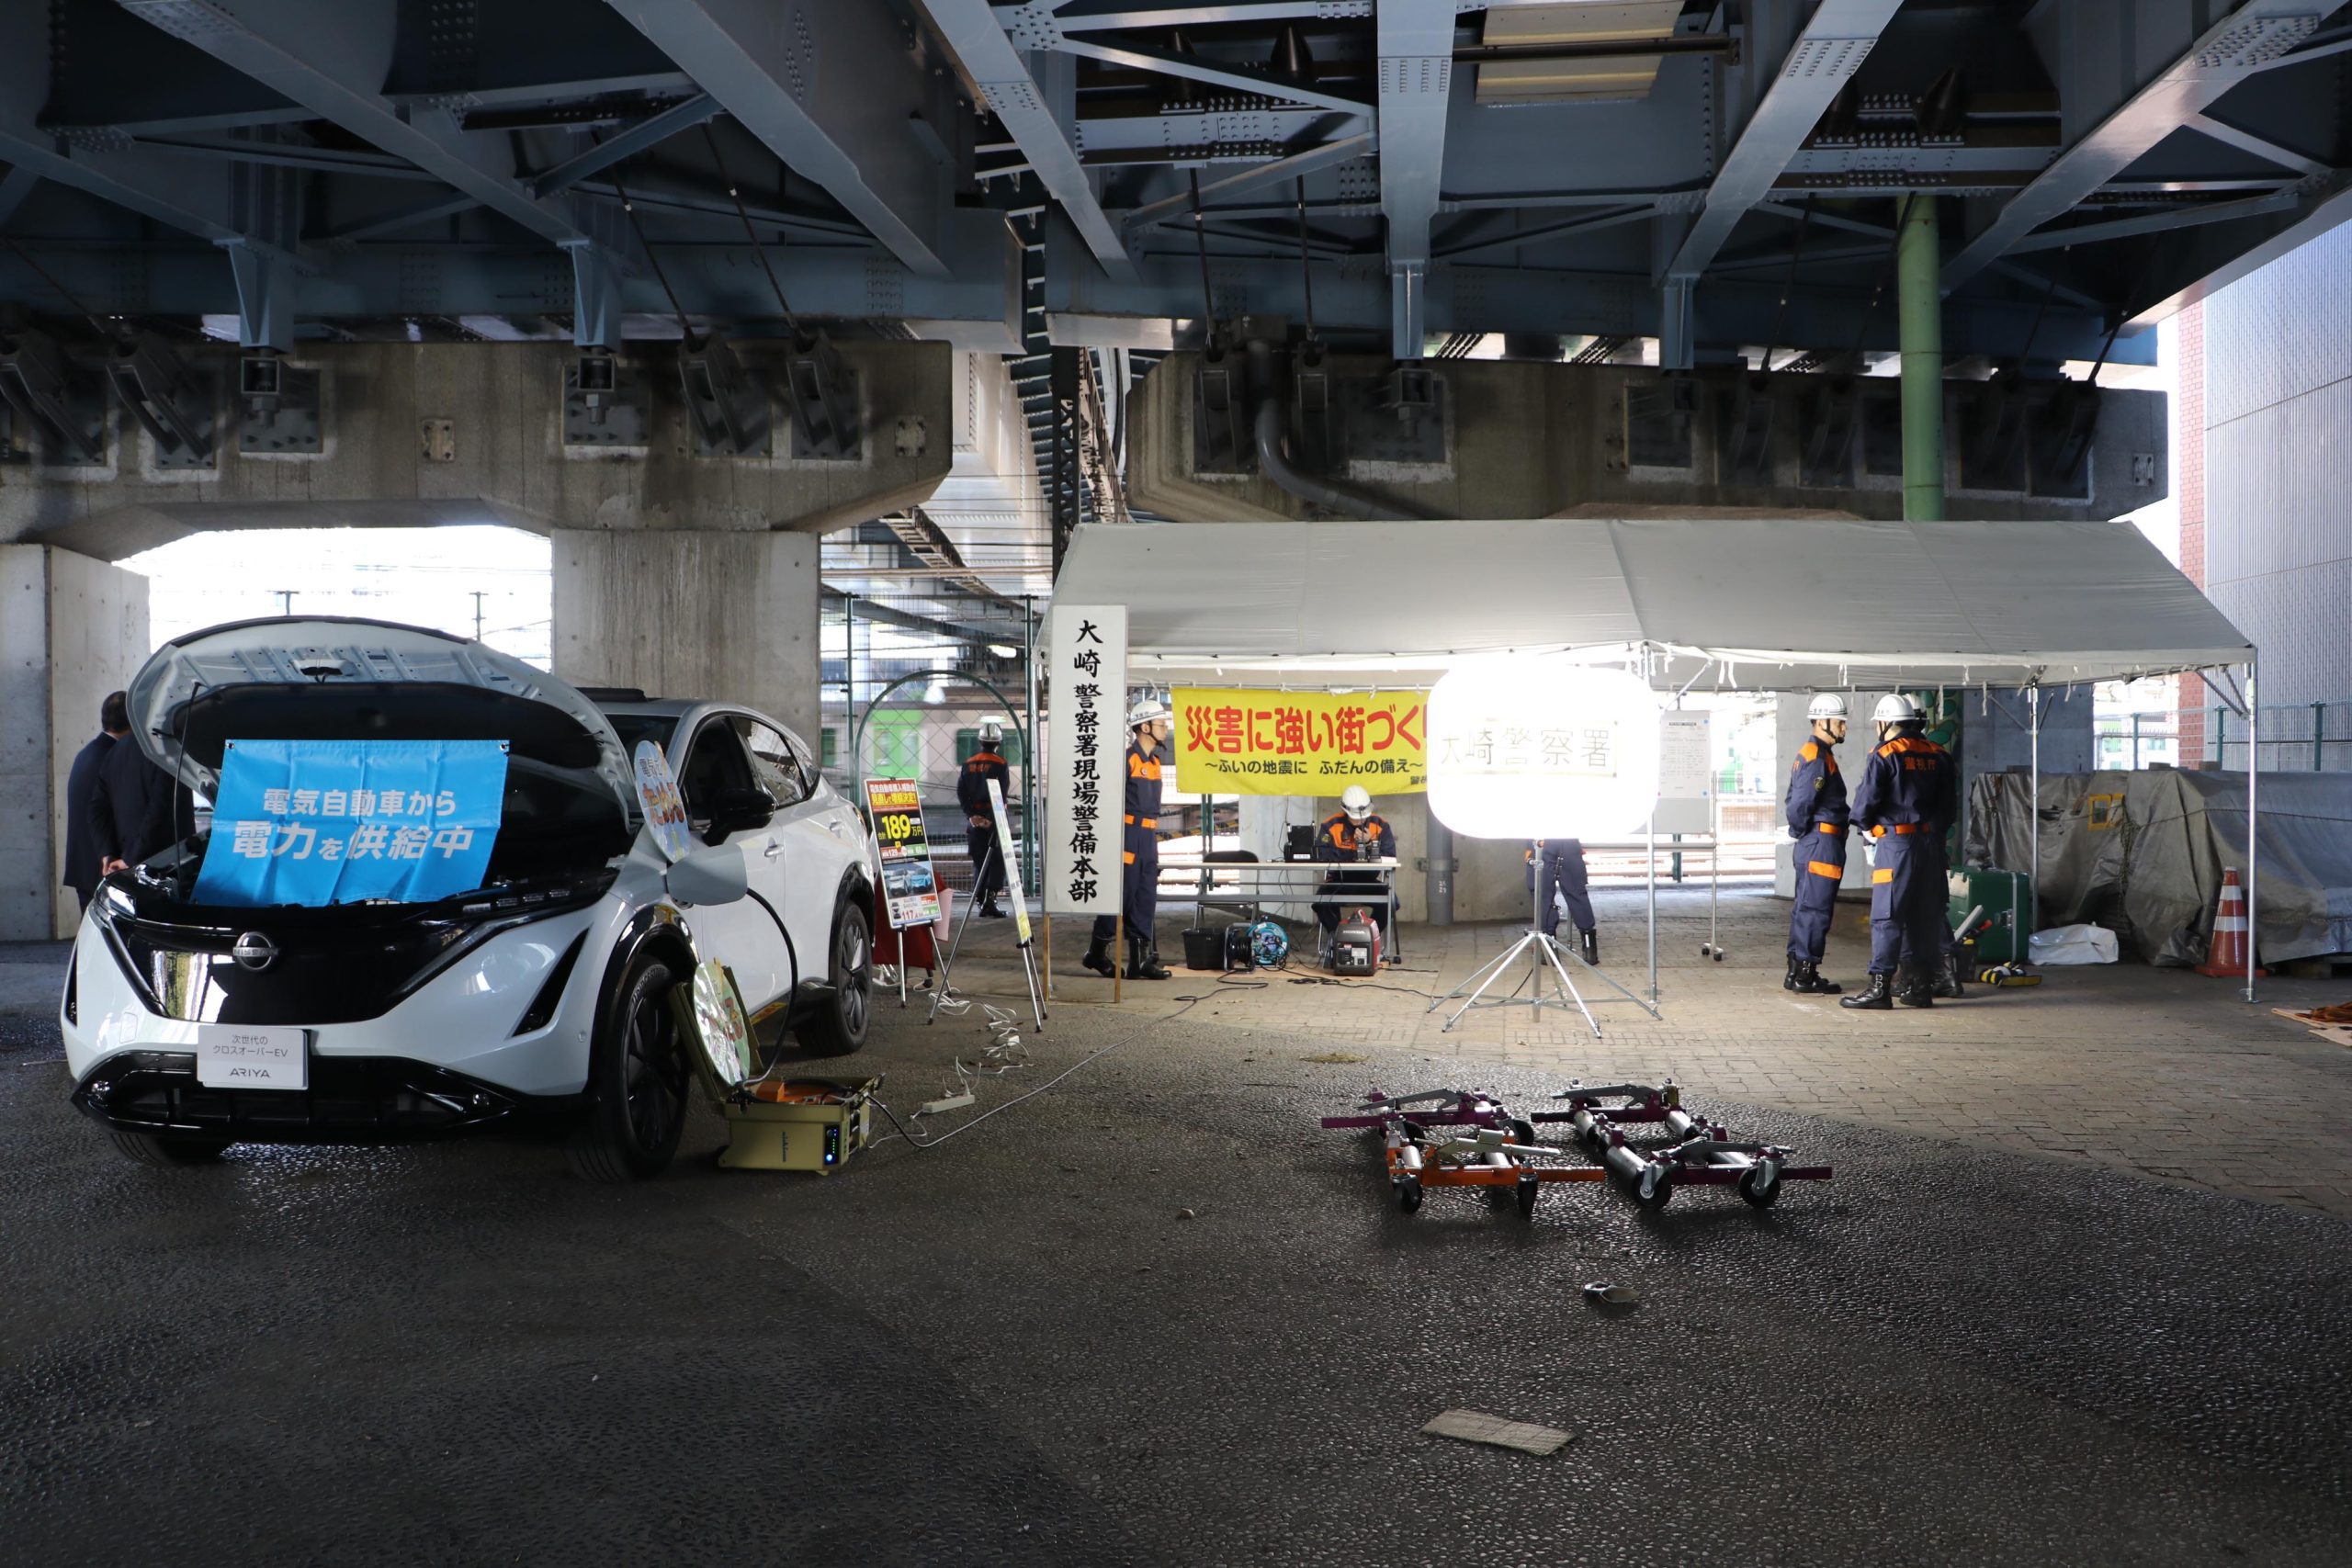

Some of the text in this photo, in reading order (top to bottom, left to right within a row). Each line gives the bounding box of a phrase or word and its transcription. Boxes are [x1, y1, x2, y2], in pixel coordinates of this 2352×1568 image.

[1441, 728, 1610, 767] 大崎警察署
[1068, 619, 1103, 904] 大崎警察署現場警備本部
[263, 788, 457, 817] 電気自動車から
[232, 820, 475, 860] 電力を供給中
[881, 814, 911, 840] 189
[233, 947, 279, 956] NISSAN
[213, 1045, 288, 1057] クロスオーバーEV
[232, 1035, 268, 1045] 次世代の
[229, 1067, 272, 1078] ARIYA
